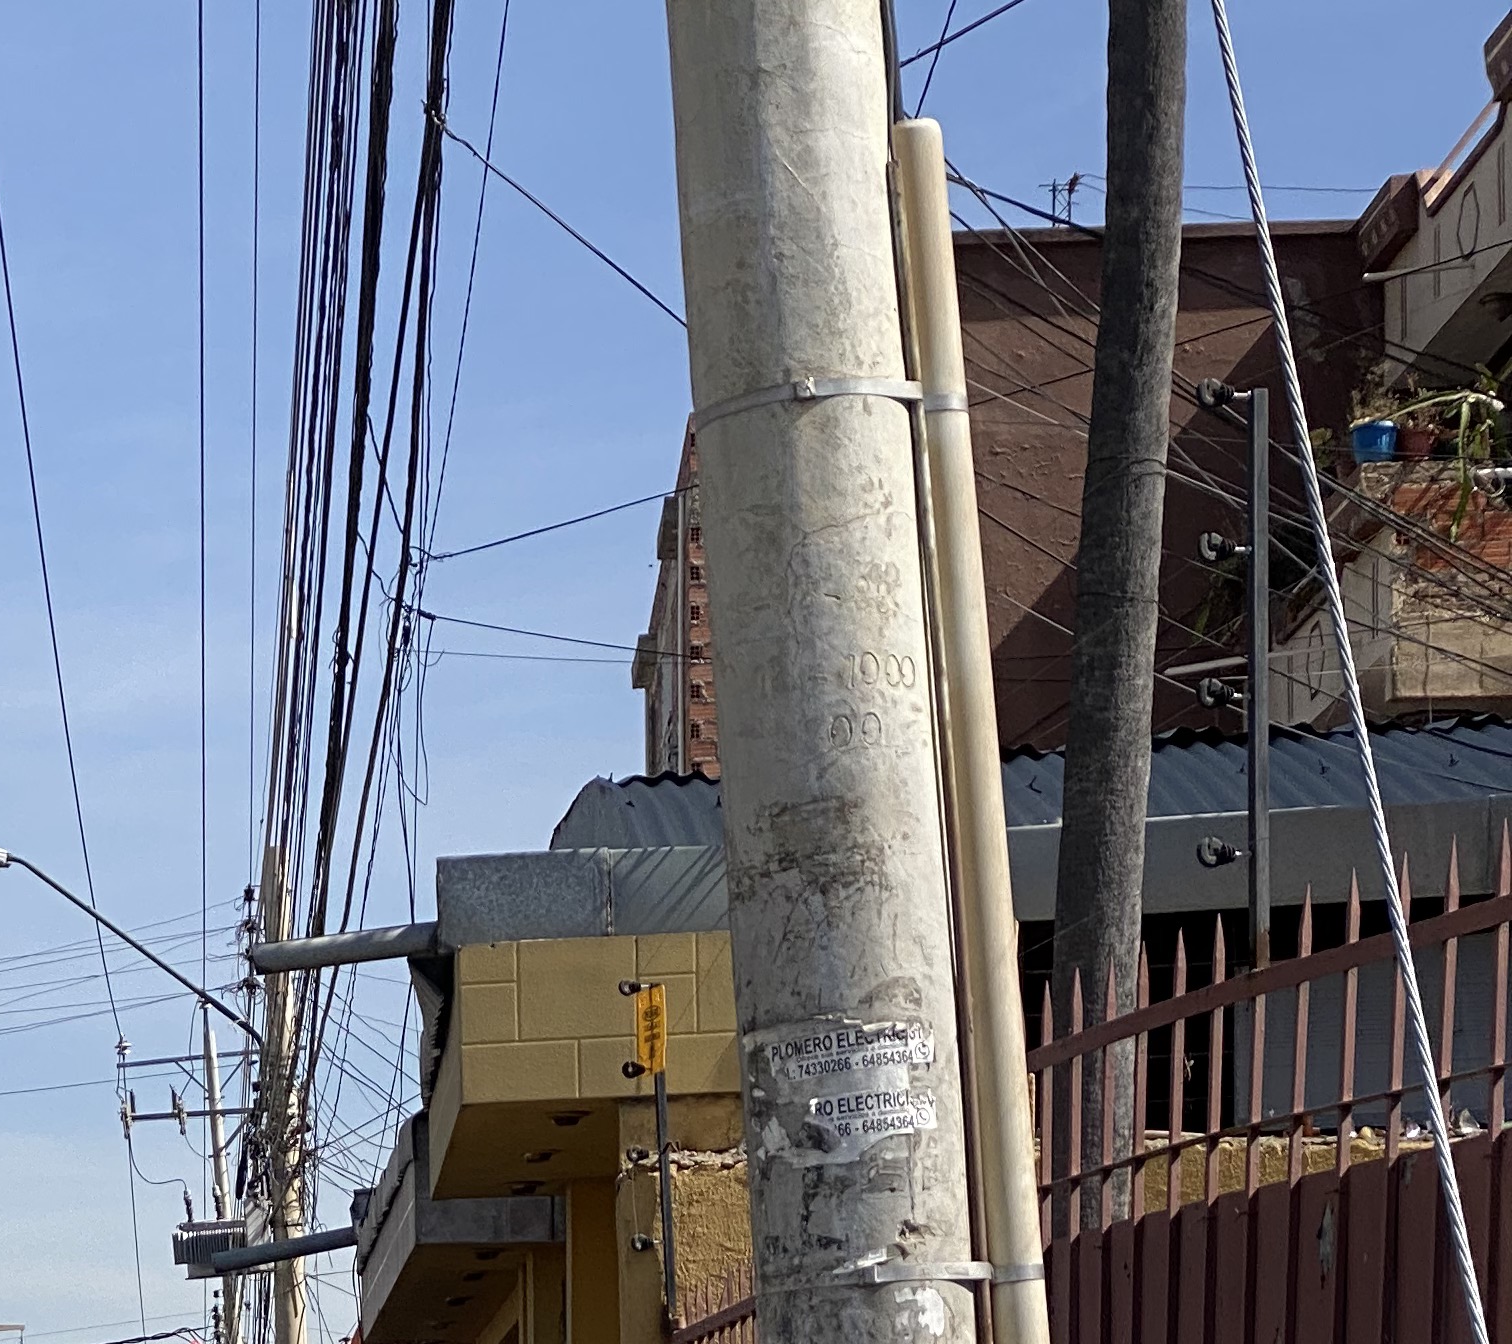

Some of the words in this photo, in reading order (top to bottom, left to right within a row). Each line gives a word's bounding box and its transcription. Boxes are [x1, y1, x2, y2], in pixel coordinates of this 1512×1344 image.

[771, 1034, 833, 1063] PLOMERO
[797, 1056, 852, 1078] 74330266
[862, 1049, 914, 1068] 64854364
[862, 1115, 915, 1134] 64854364
